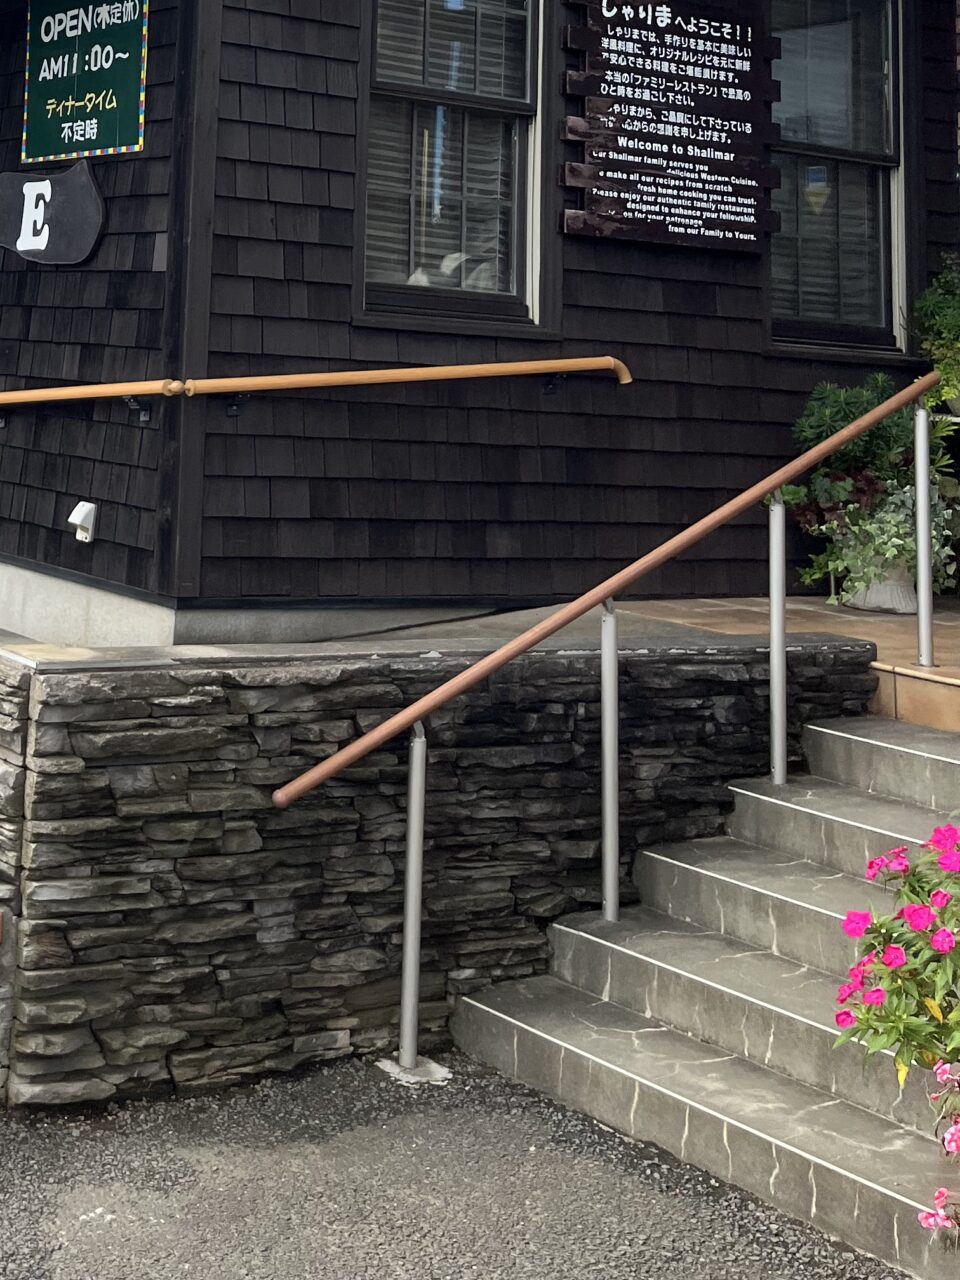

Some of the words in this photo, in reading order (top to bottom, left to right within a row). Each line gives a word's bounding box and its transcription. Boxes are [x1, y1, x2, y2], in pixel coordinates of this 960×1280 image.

[45, 88, 117, 119] ディナータイム
[60, 117, 98, 144] 不定時
[608, 147, 642, 163] Shalimar
[643, 155, 667, 167] family
[669, 161, 694, 171] serves
[695, 164, 709, 173] you
[617, 136, 669, 153] Welcome
[672, 143, 684, 155] to
[687, 145, 736, 162] Shalimar
[606, 171, 628, 180] make
[629, 173, 640, 181] all
[641, 175, 654, 183] our
[655, 177, 684, 188] recipes
[685, 179, 703, 189] from
[705, 181, 733, 192] scratch
[620, 191, 641, 202] enjoy
[643, 194, 656, 203] our
[657, 195, 692, 207] authentic
[717, 203, 755, 215] restaurant
[637, 183, 657, 193] fresh
[658, 186, 678, 196] home
[679, 188, 708, 200] cooking
[709, 193, 722, 202] you
[723, 195, 737, 203] can
[737, 196, 757, 205] trust.
[626, 201, 660, 213] designed
[661, 205, 670, 213] to
[671, 206, 701, 218] enhance
[702, 211, 719, 220] your
[647, 214, 664, 223] your
[665, 215, 703, 227] patronage
[668, 224, 686, 234] from
[687, 227, 700, 235] our
[700, 228, 724, 239] Family
[725, 230, 733, 238] to
[734, 231, 757, 241] Yours.
